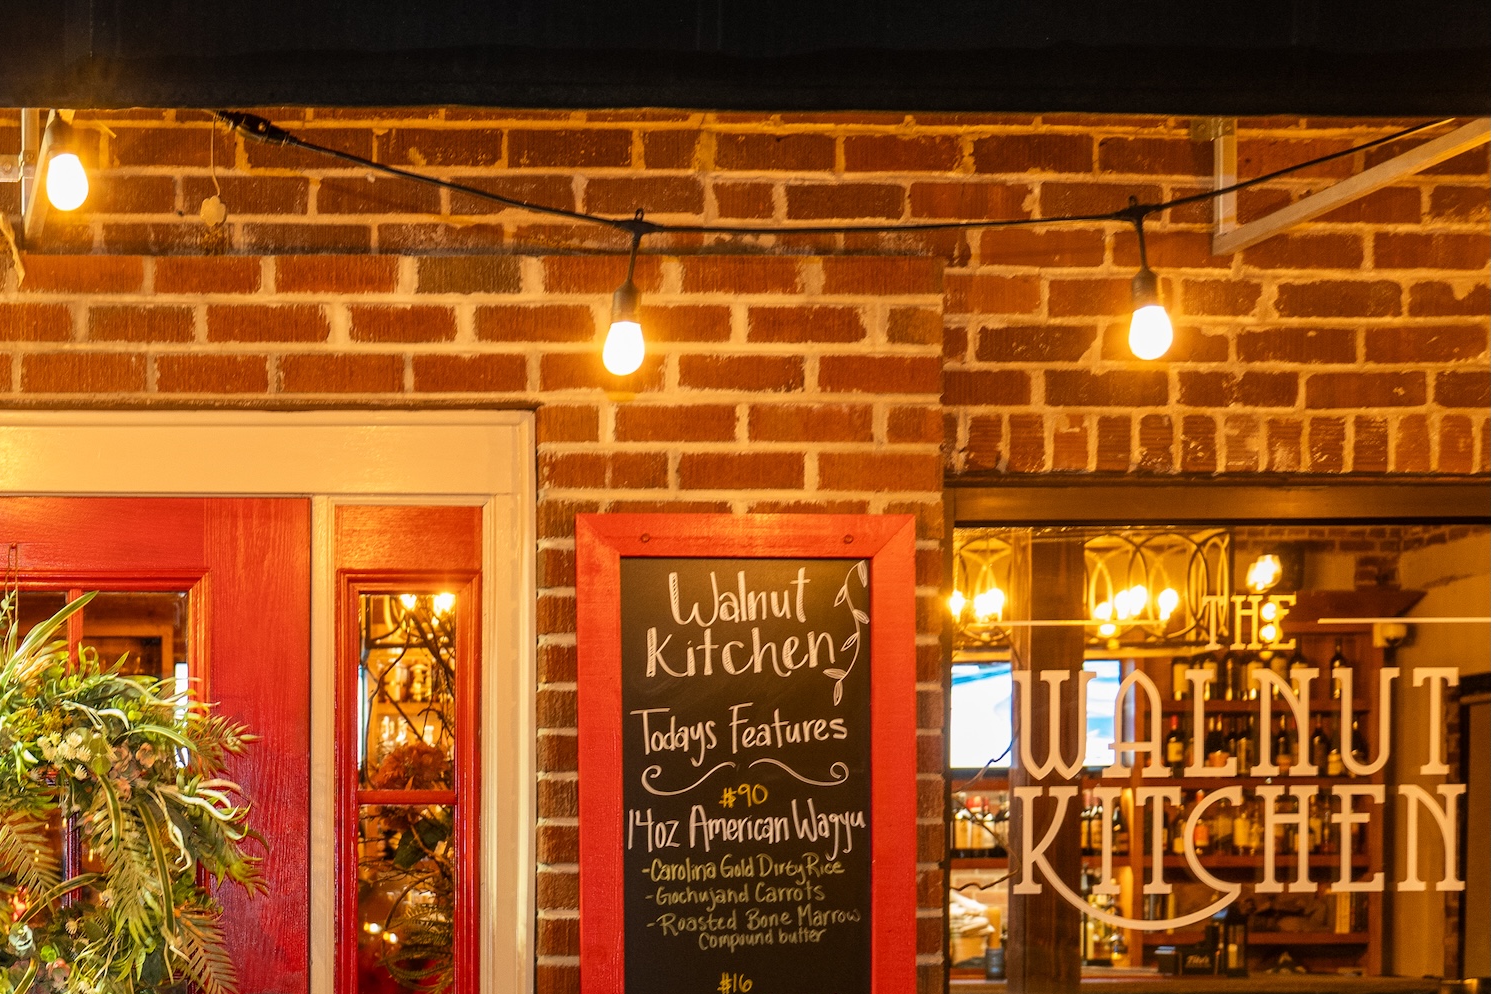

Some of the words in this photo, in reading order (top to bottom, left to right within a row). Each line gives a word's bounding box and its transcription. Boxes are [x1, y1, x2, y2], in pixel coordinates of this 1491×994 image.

[668, 567, 811, 627] Walnut
[1202, 592, 1297, 650] THE
[646, 627, 835, 677] Kitchen
[630, 707, 717, 767] Todays
[728, 702, 848, 754] Features
[1012, 667, 1460, 781] WALNUT
[628, 808, 681, 852] 14oz
[689, 804, 790, 852] American
[791, 798, 866, 861] Wagyu
[1013, 784, 1467, 931] KITCHEN
[721, 853, 754, 879] Gold
[755, 880, 826, 903] Carrots
[699, 928, 773, 953] Compound
[779, 928, 827, 944] butter
[745, 908, 792, 931] Bone
[798, 903, 861, 927] Marrow
